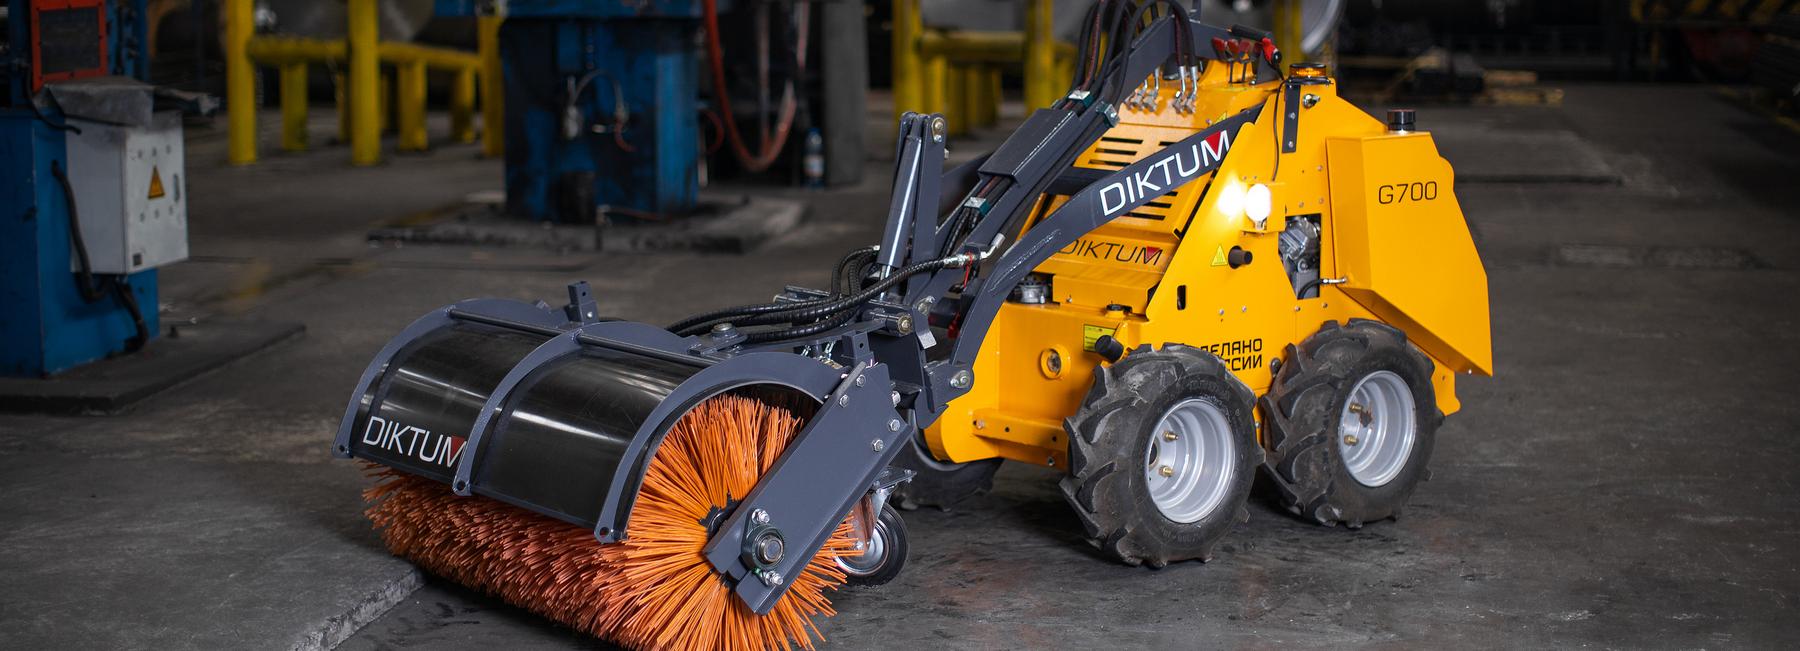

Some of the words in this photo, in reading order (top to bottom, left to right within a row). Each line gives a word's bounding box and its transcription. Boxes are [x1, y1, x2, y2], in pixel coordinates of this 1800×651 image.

[1099, 130, 1230, 216] DIKTUM
[1378, 181, 1437, 204] G700
[362, 415, 467, 468] DIKTUM
